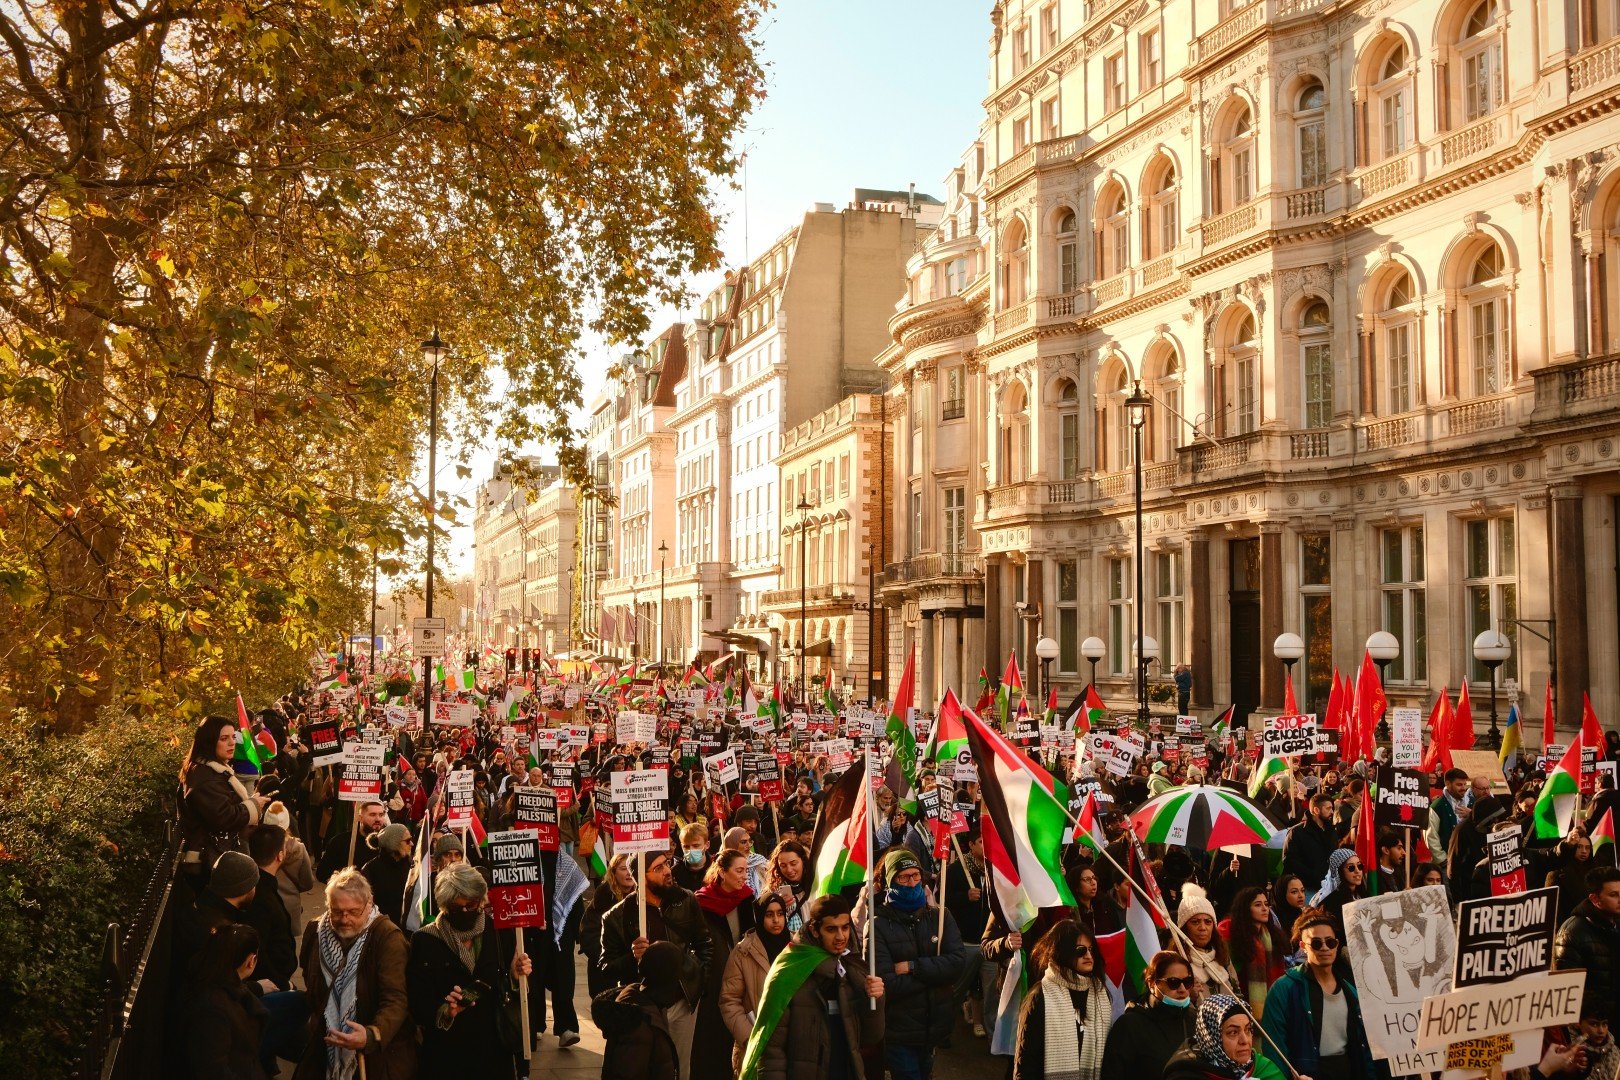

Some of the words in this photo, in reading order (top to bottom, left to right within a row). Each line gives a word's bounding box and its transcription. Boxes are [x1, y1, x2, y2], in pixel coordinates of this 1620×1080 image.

[1274, 715, 1310, 730] STOP
[311, 728, 337, 744] FREE
[1008, 730, 1039, 739] Palestine
[1264, 726, 1315, 742] GENOCIDE
[1316, 733, 1330, 742] ree
[313, 739, 339, 750] PALESTINE
[1281, 737, 1314, 754] GAZA
[1316, 742, 1338, 753] estine
[1395, 752, 1411, 760] END
[342, 771, 359, 779] STATE
[360, 772, 380, 780] TERROR
[346, 764, 357, 772] END
[358, 765, 378, 773] ISRAELI
[551, 778, 573, 787] PALESTINE
[1074, 781, 1102, 795] Free
[1394, 772, 1419, 791] Free
[518, 795, 553, 808] FREEDOM
[1067, 790, 1115, 811] Paletine
[1378, 787, 1429, 809] Palestine
[620, 802, 634, 813] END
[635, 800, 662, 812] ISRAELI
[517, 809, 556, 823] PALESTINE
[615, 812, 638, 823] STATE
[639, 810, 666, 822] TERROR
[620, 824, 631, 832] FOR
[632, 824, 637, 832] A
[637, 822, 662, 831] SOCIALIST
[492, 843, 535, 860] FREEDOM
[1492, 836, 1519, 857] FREEDOM
[1492, 855, 1522, 876] PALESTINE
[492, 866, 539, 884] PALESTINE
[501, 888, 532, 905] الحرية
[500, 904, 538, 920] لفلسطين
[1468, 895, 1548, 936] FREEDOM
[1505, 932, 1519, 947] for
[1460, 938, 1548, 981] PALESTINE
[1426, 998, 1480, 1037] HOPE
[1484, 993, 1527, 1030] NOT
[1528, 985, 1580, 1022] HATE
[1396, 1050, 1446, 1072] HAT
[1448, 1049, 1467, 1060] RISE
[1469, 1048, 1484, 1058] OF
[1446, 1059, 1465, 1069] AND
